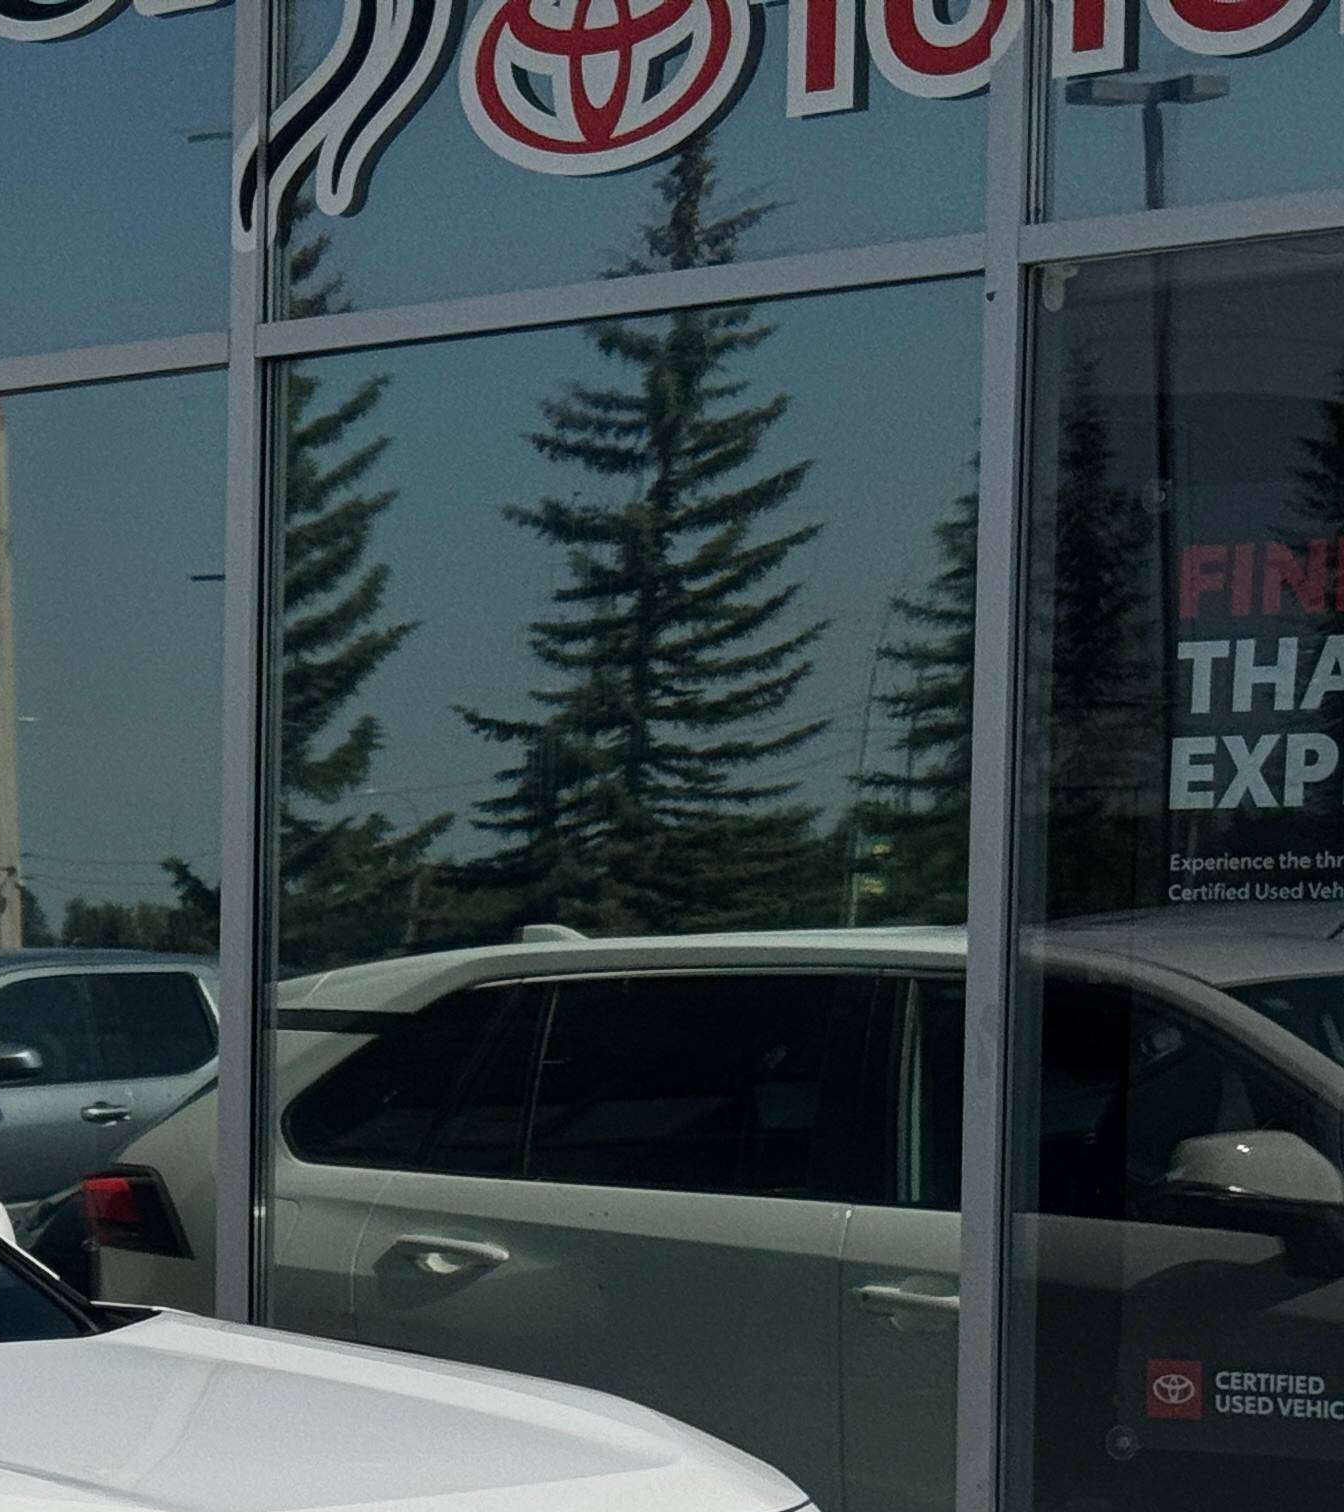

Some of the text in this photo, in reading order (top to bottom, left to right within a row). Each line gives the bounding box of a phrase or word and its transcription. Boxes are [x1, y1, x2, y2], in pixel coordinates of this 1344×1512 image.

[1178, 537, 1344, 621] FIN
[1169, 732, 1344, 811] EXP
[1169, 852, 1275, 876] Experience
[1278, 850, 1312, 870] the
[1168, 881, 1251, 901] Certified
[1255, 881, 1305, 900] Used
[1214, 1371, 1326, 1396] CERTIFIED
[1214, 1395, 1344, 1420] USED VEHIC
